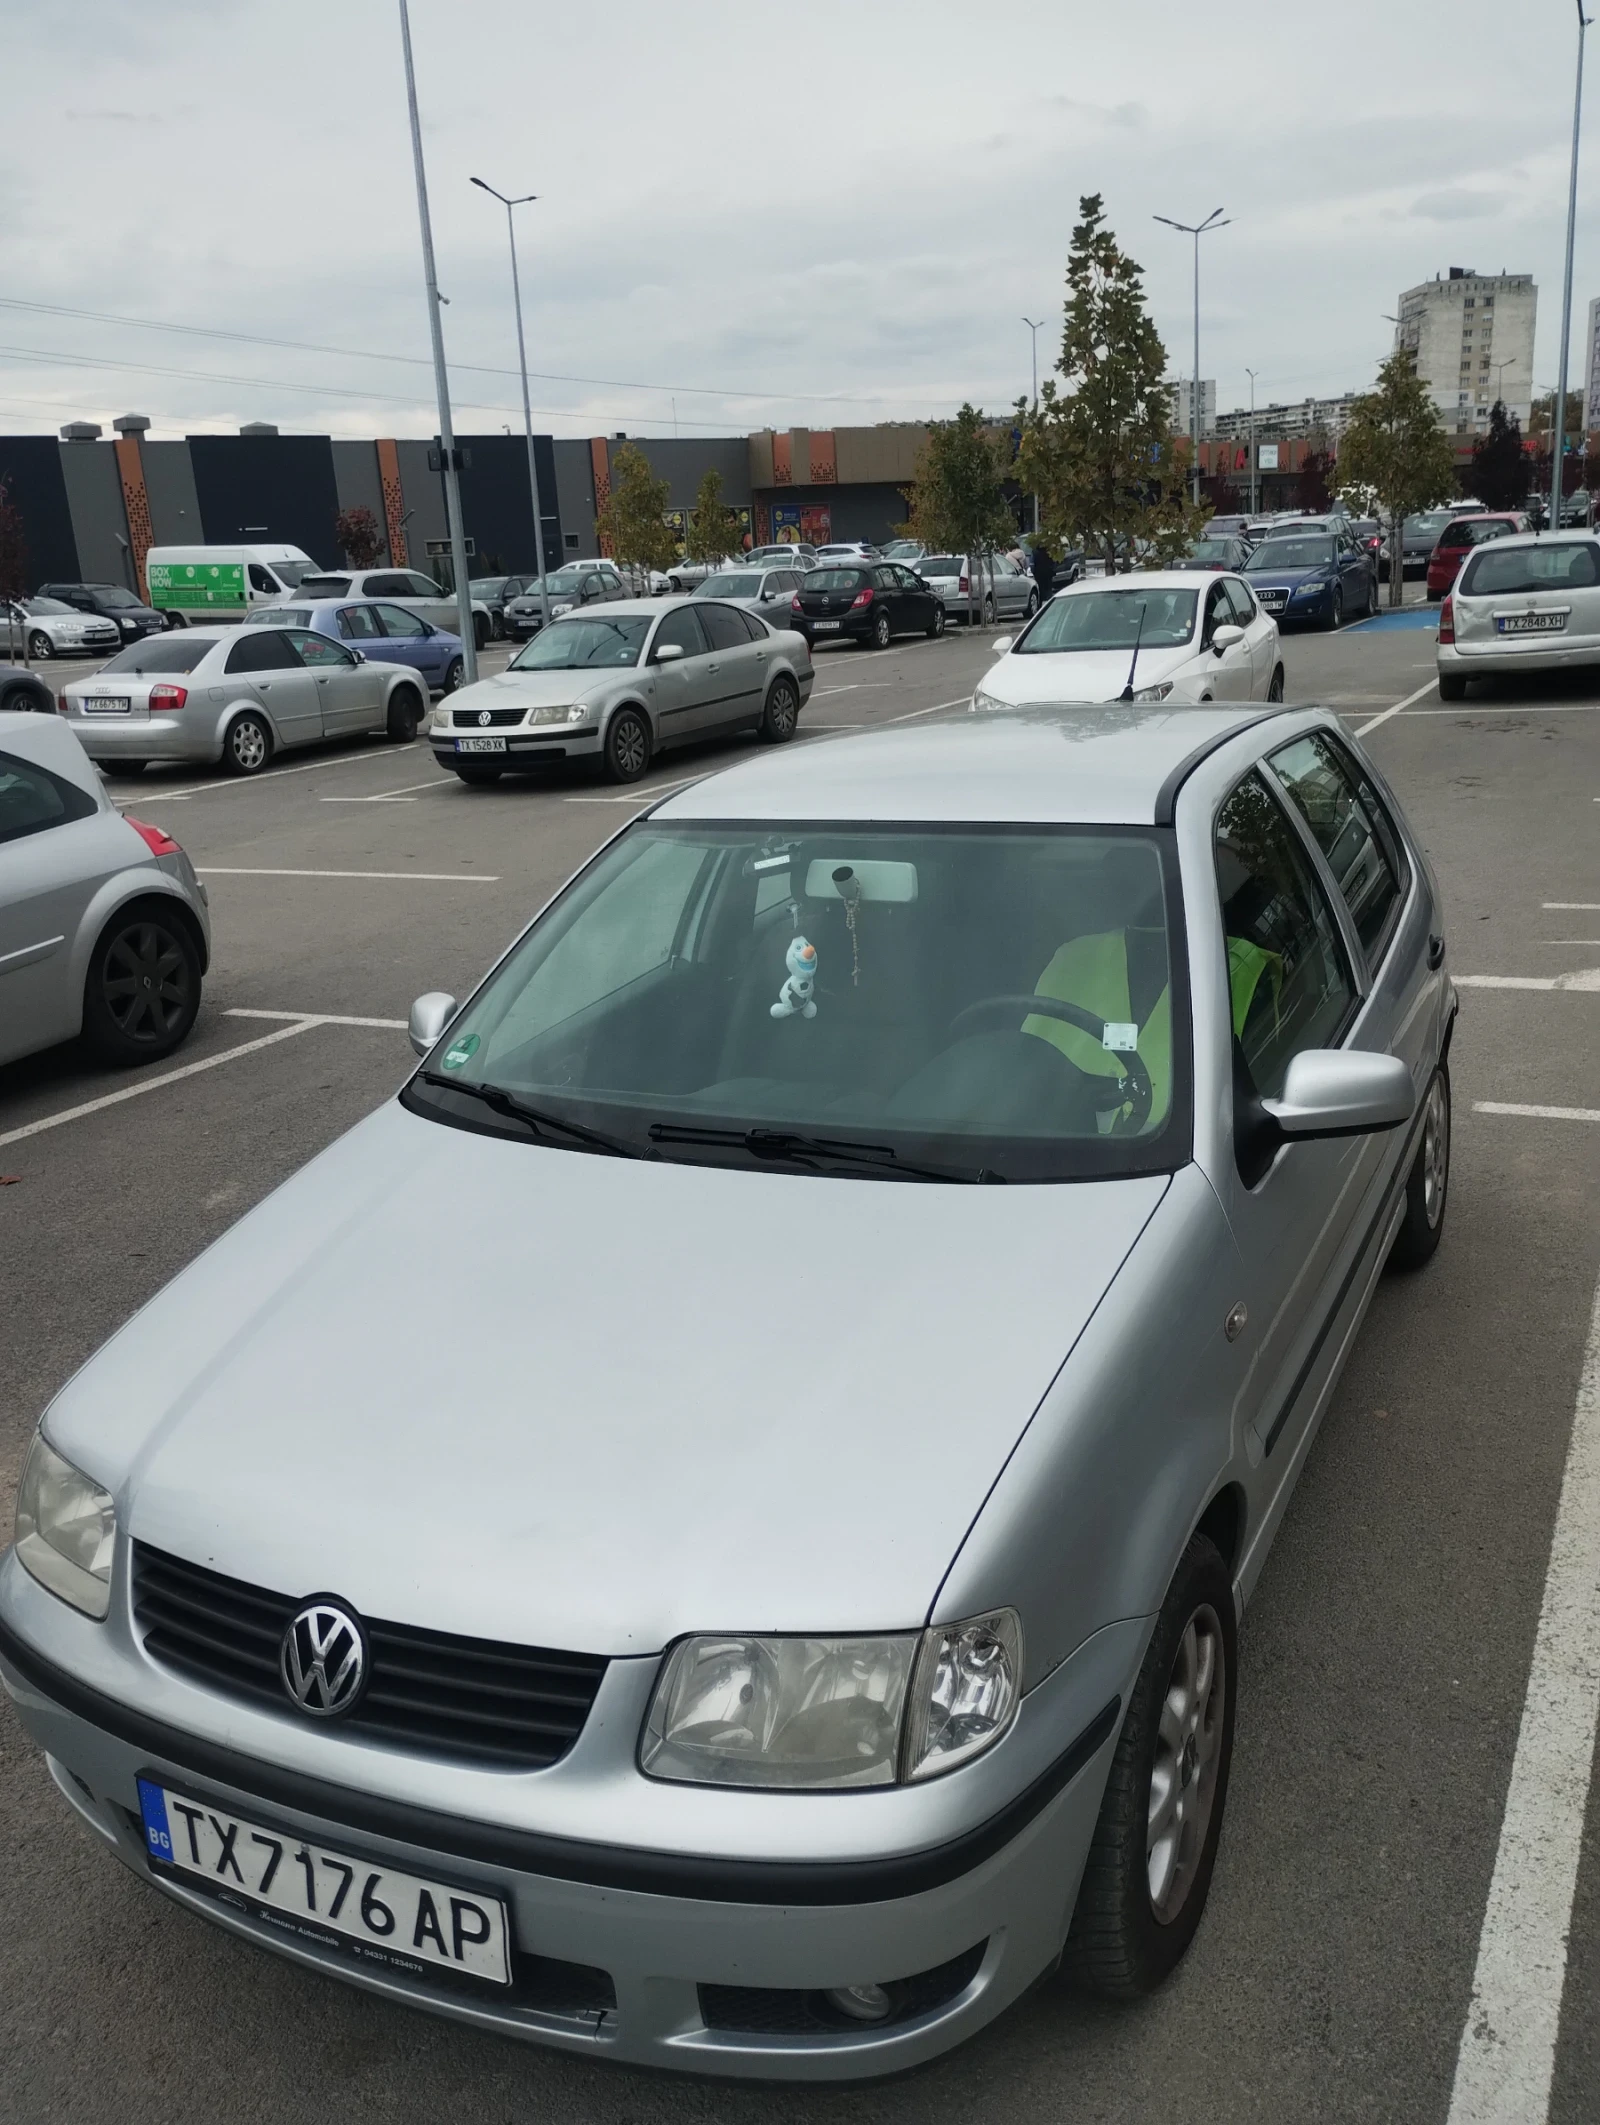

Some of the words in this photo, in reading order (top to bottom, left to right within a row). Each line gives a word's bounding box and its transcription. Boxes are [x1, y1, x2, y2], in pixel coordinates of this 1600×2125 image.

[150, 566, 170, 577] BOX
[151, 577, 172, 588] NOW
[1506, 618, 1519, 630] TX
[1521, 616, 1546, 629] 2848
[1548, 615, 1562, 626] XH
[460, 740, 471, 751] TX
[472, 740, 492, 751] 1528
[492, 739, 505, 751] XK
[148, 1826, 170, 1849] BG
[413, 1887, 491, 1961] AP
[297, 1927, 339, 1947] Automobile
[363, 1949, 388, 1961] 04331
